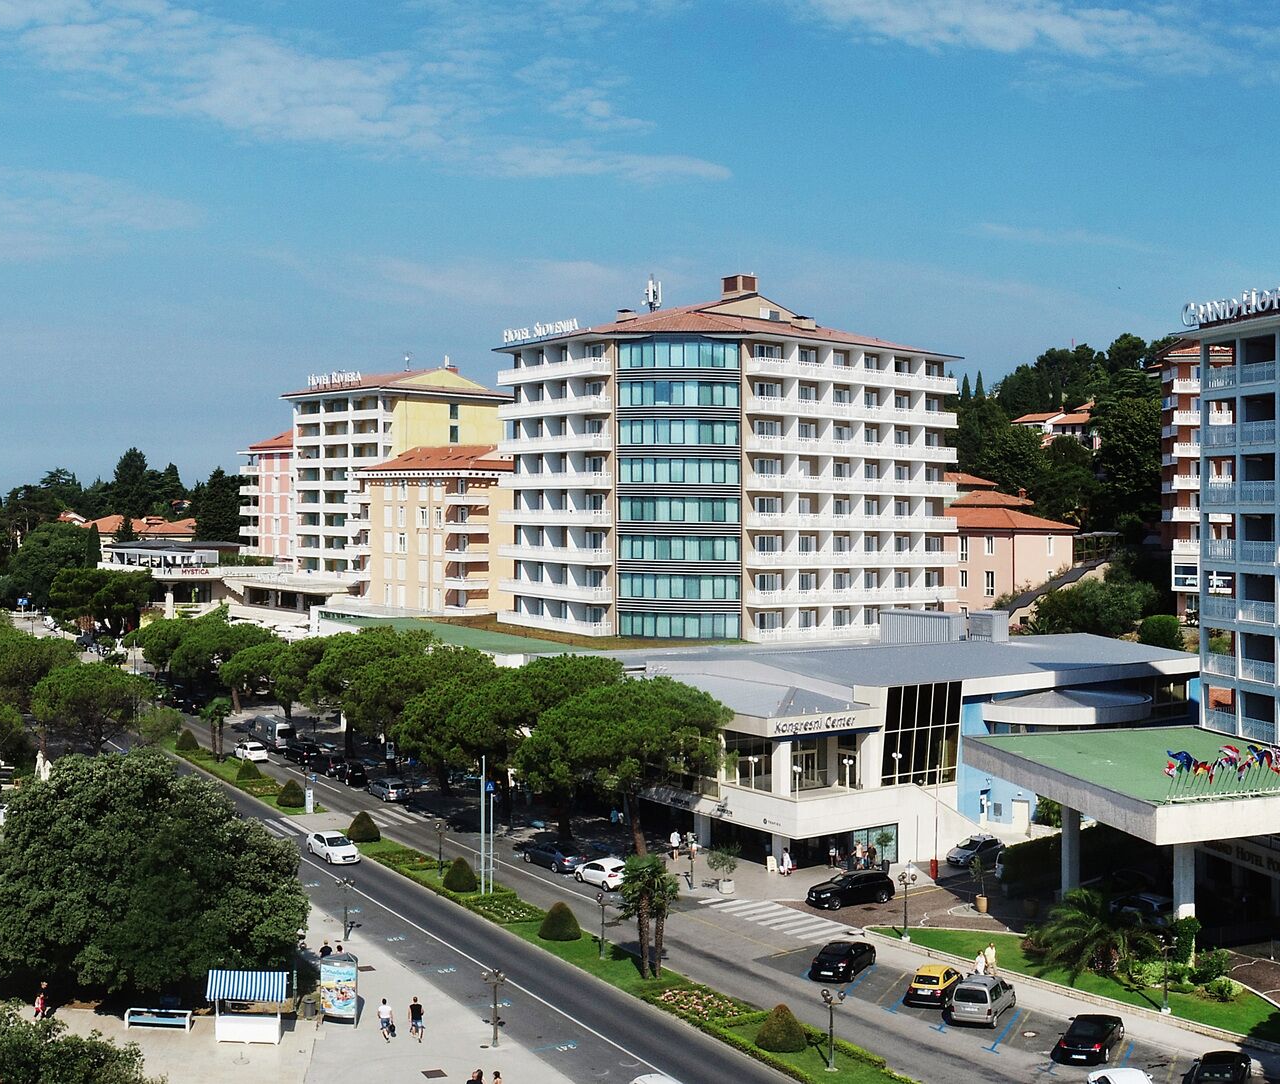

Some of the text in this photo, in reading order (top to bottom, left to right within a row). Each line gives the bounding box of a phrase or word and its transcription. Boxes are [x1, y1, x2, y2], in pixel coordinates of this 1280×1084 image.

[1181, 299, 1238, 327] GRAND
[503, 328, 531, 342] HOTEL
[308, 371, 361, 386] HOTEL RIVIERA
[774, 716, 856, 735] Kongresni Center
[1236, 846, 1264, 867] HOTEL
